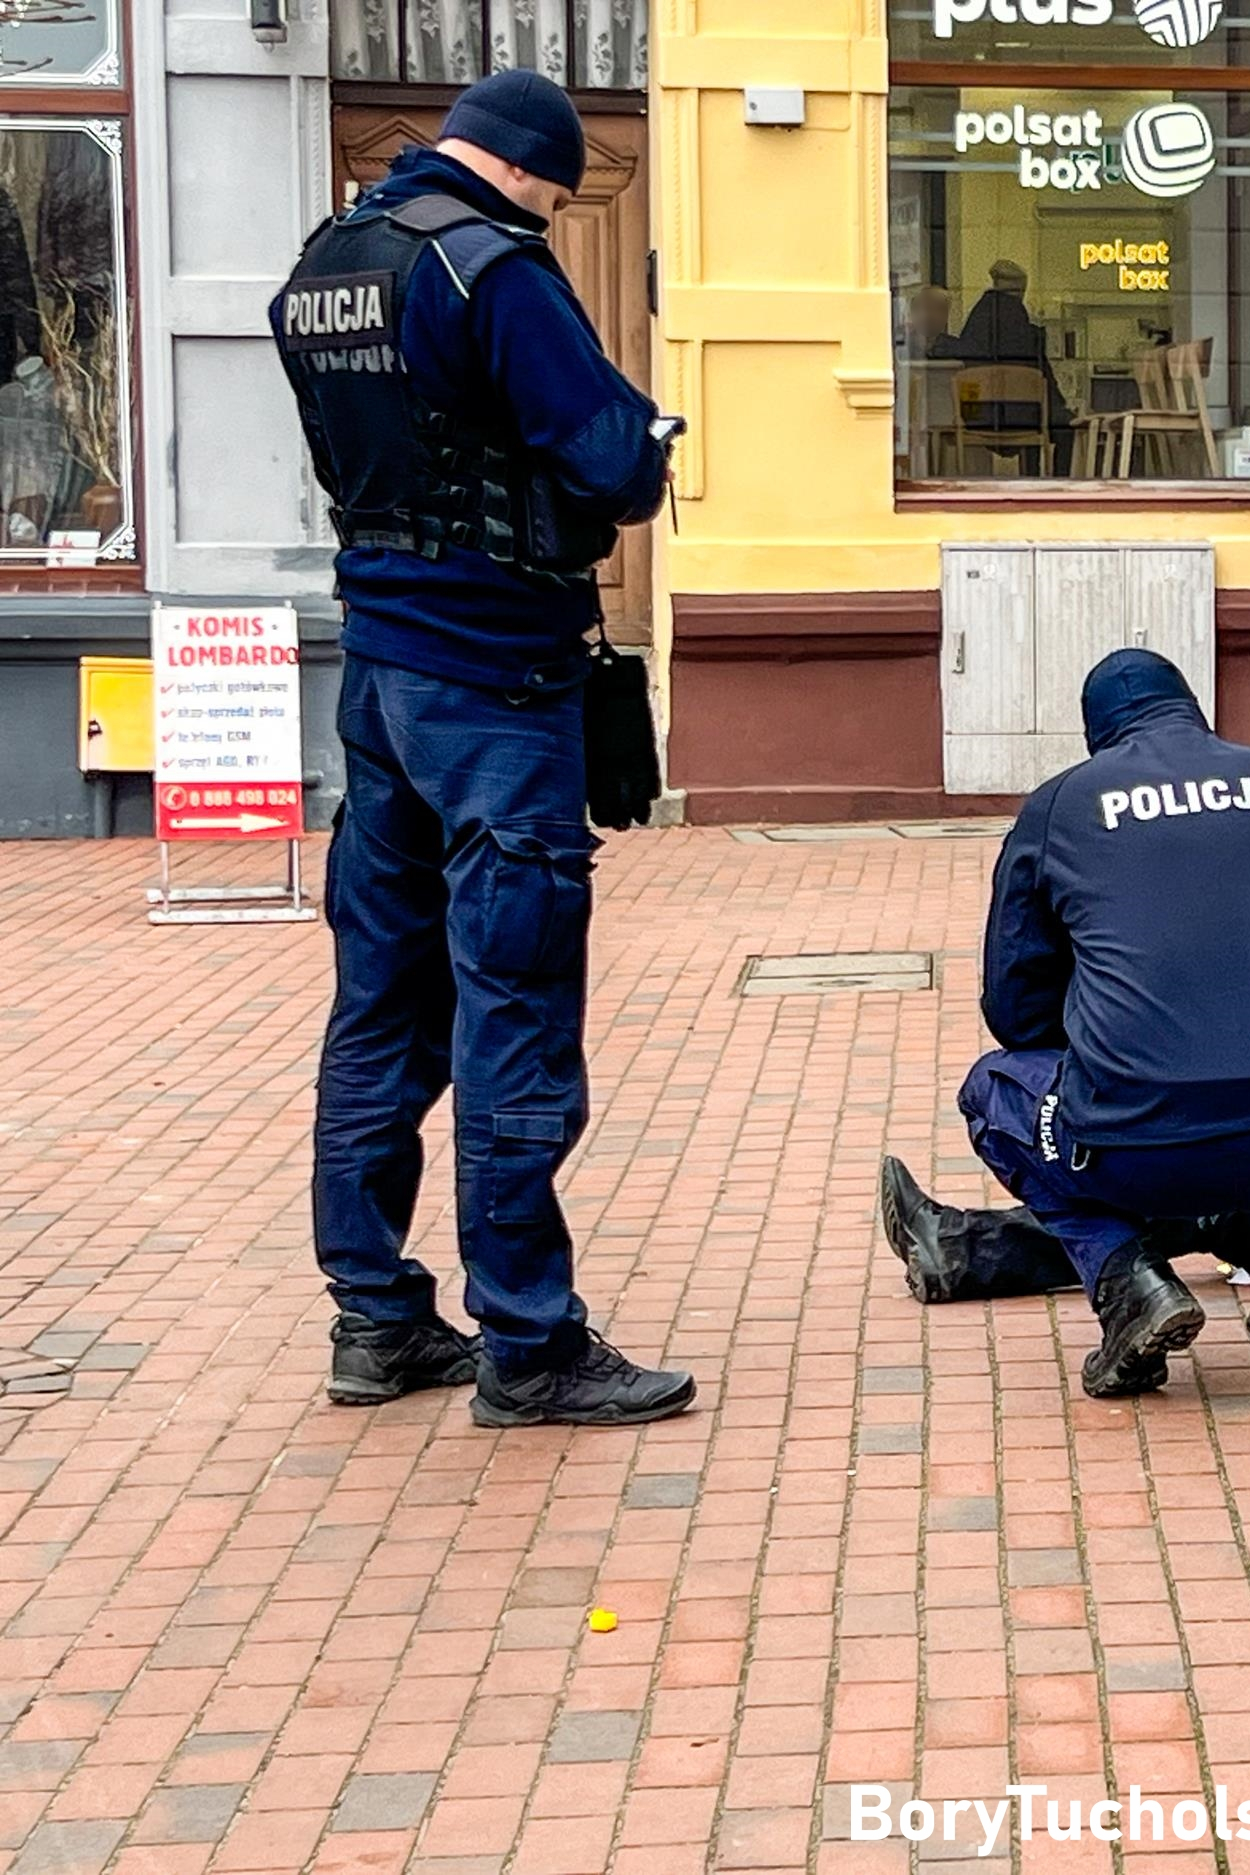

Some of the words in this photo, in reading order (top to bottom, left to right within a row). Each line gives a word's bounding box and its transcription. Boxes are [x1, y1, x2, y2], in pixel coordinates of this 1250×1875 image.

[955, 104, 1102, 152] polsat
[1020, 148, 1101, 189] box
[1080, 238, 1169, 270] polsat
[1119, 265, 1169, 291] box
[285, 285, 385, 337] POLICJA
[187, 616, 265, 637] KOMIS
[1040, 1094, 1059, 1162] POLICJA
